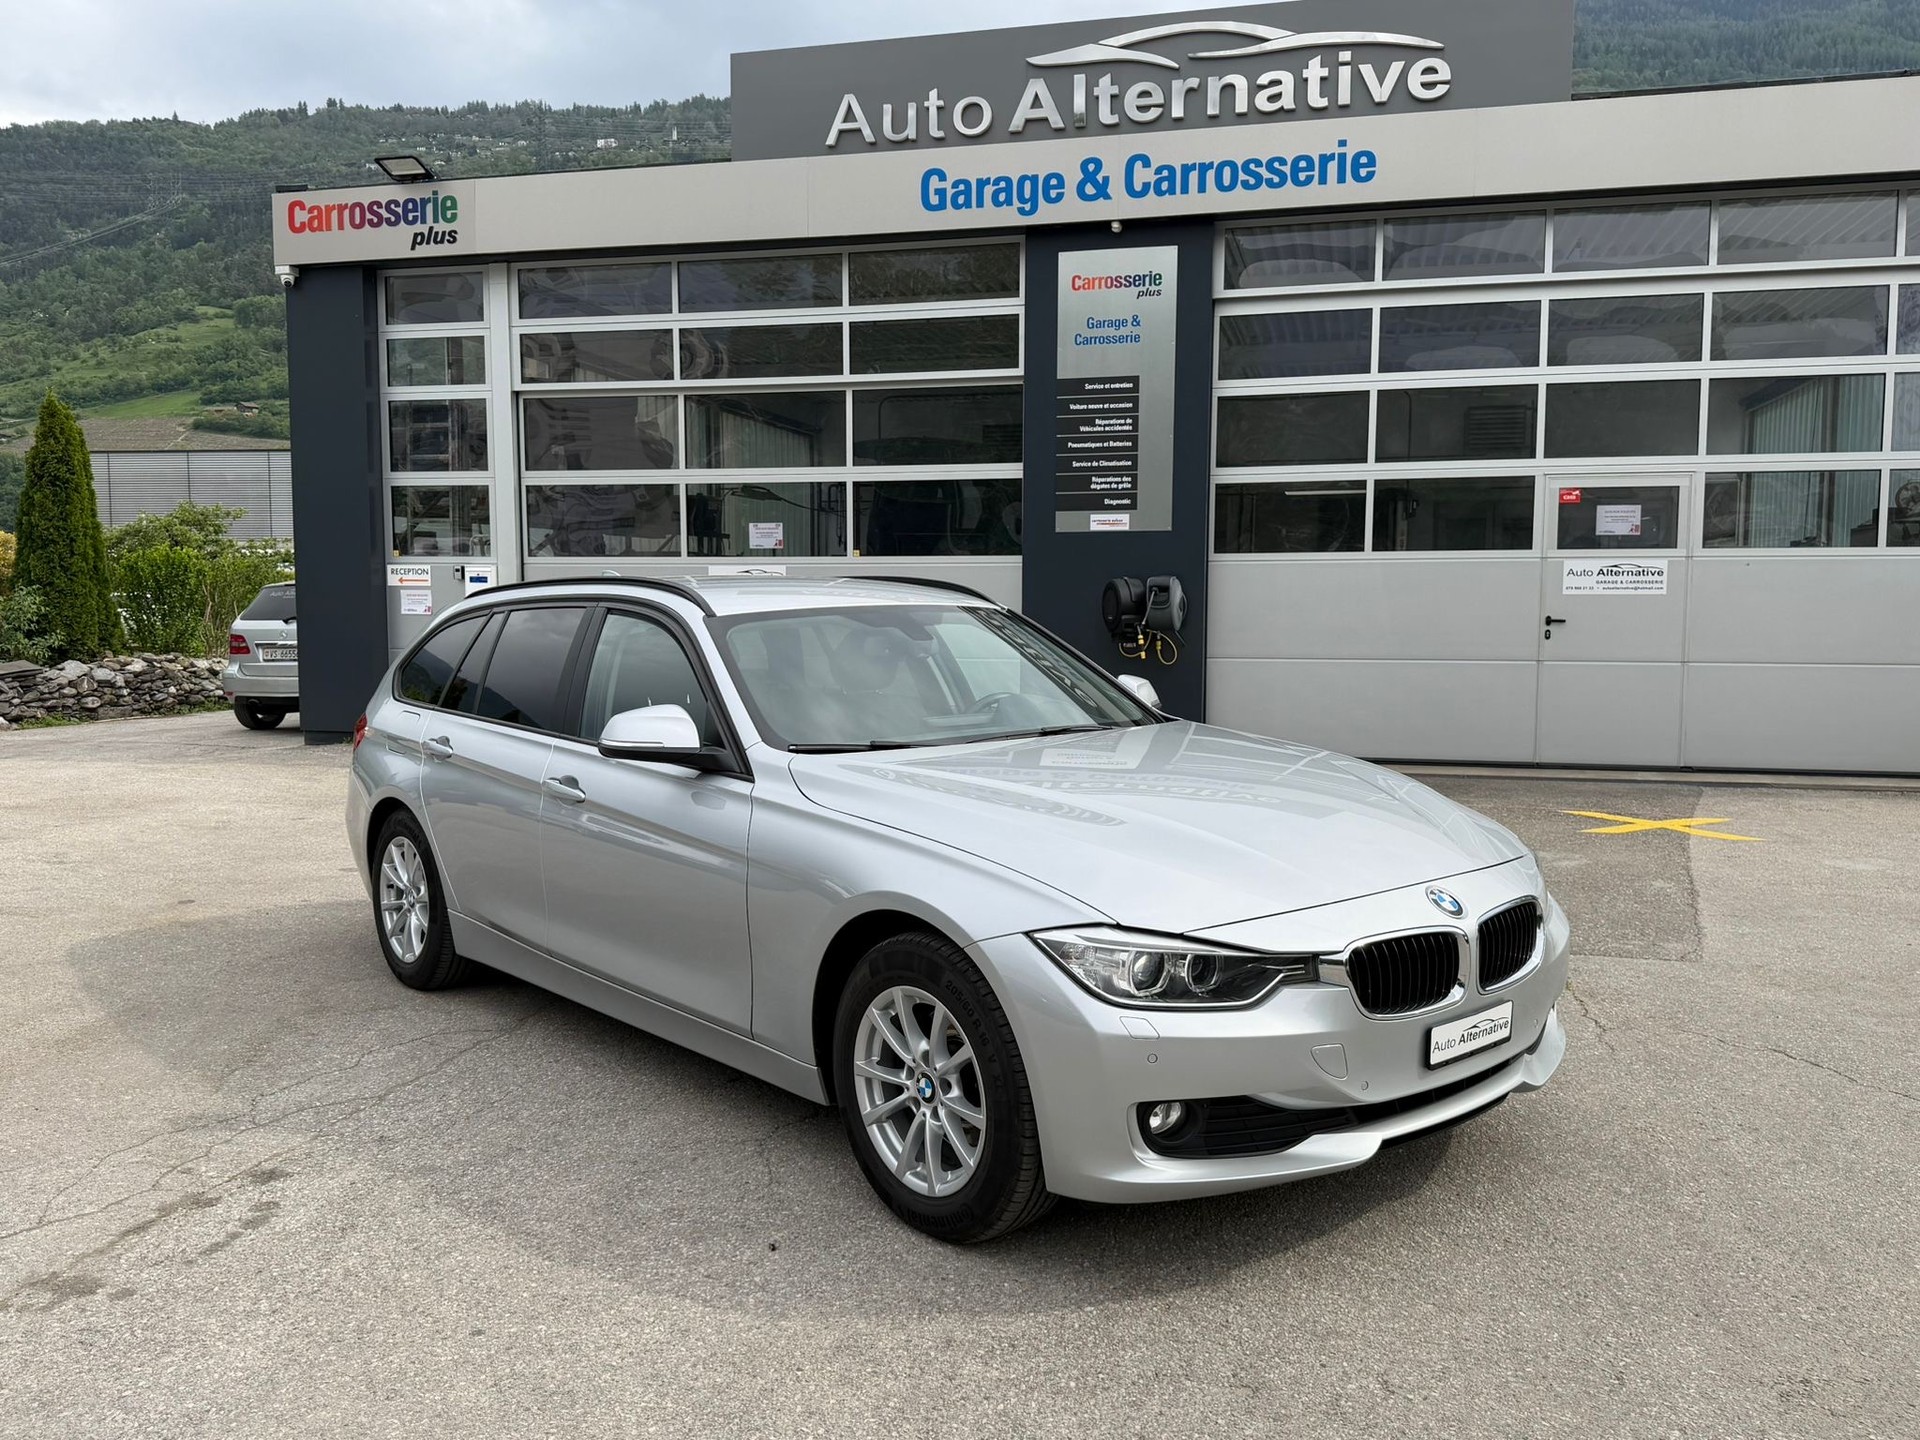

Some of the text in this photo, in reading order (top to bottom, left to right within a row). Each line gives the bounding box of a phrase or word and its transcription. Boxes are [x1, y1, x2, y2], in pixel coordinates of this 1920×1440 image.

[825, 50, 1453, 148] Auto Alternative
[920, 139, 1377, 216] Garage & Carrosserie
[287, 190, 458, 234] Carrosserie
[410, 226, 458, 251] plus
[1071, 271, 1163, 291] Carrosserie
[1137, 288, 1162, 299] plus
[1086, 314, 1141, 331] Garage &
[1074, 331, 1141, 346] Carrosserie
[1084, 382, 1104, 390] Service
[1068, 441, 1103, 449] Pneumatiques
[1104, 498, 1131, 506] Diagnostic
[390, 567, 429, 576] RECEPTION
[1566, 567, 1664, 577] Auto Alternative
[270, 649, 277, 658] VS
[1432, 1019, 1509, 1053] Auto Alternative
